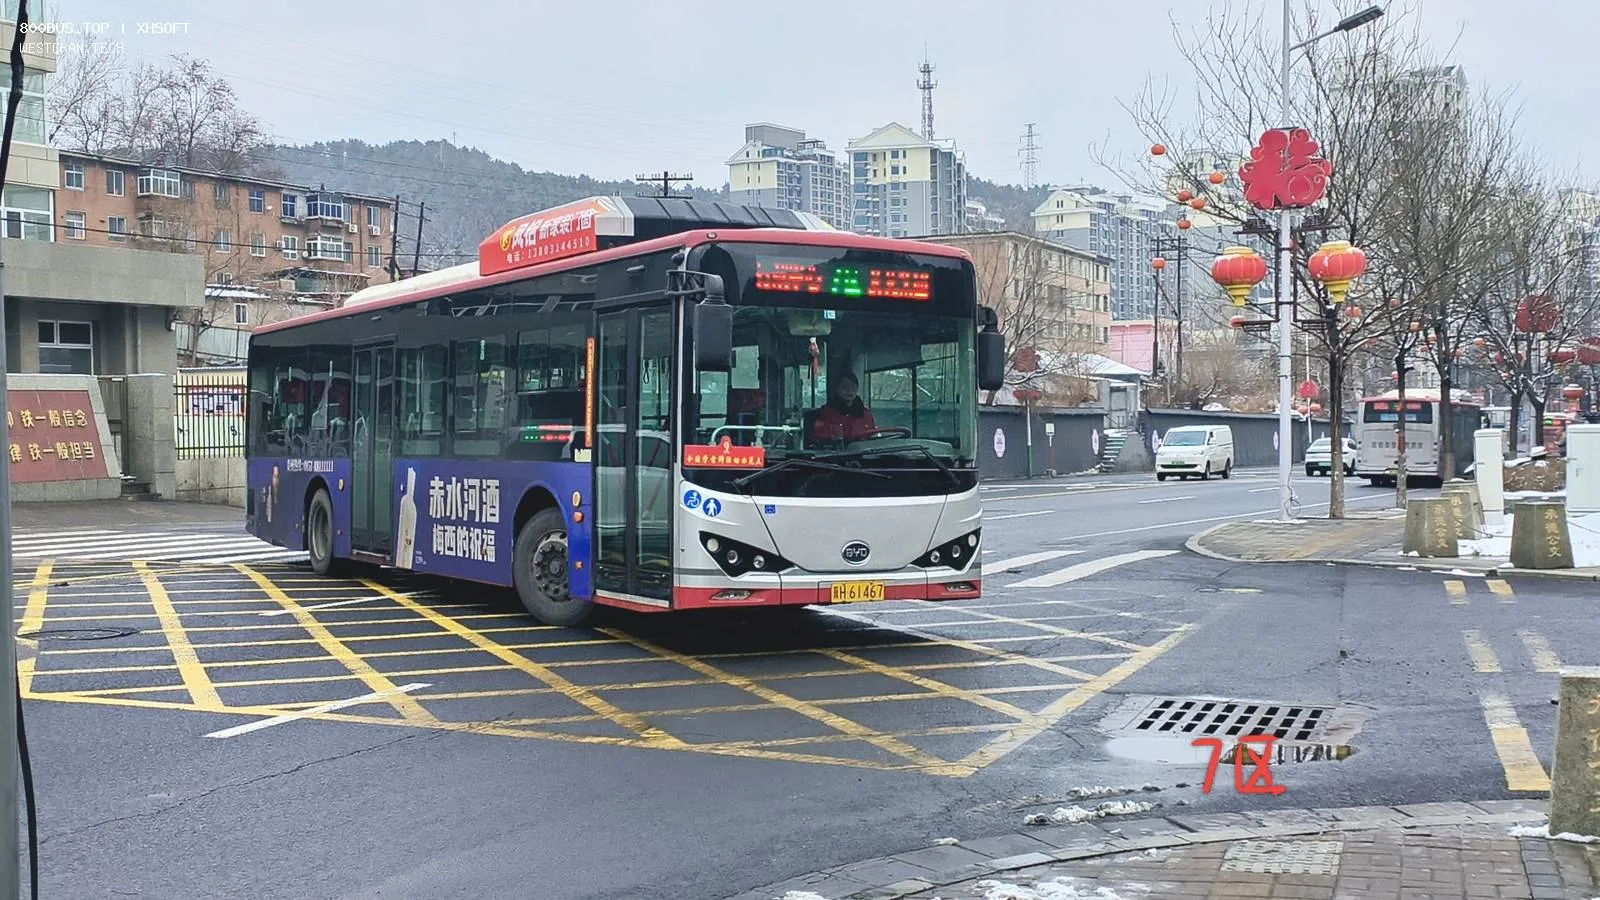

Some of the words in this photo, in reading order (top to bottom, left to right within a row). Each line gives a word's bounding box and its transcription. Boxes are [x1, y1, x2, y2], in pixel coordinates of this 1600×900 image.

[20, 408, 88, 428] 铁一般信念
[28, 441, 96, 461] 铁一般担当
[429, 476, 500, 524] 赤水河酒
[432, 524, 497, 563] 梅西的祝福
[845, 547, 868, 557] BYD
